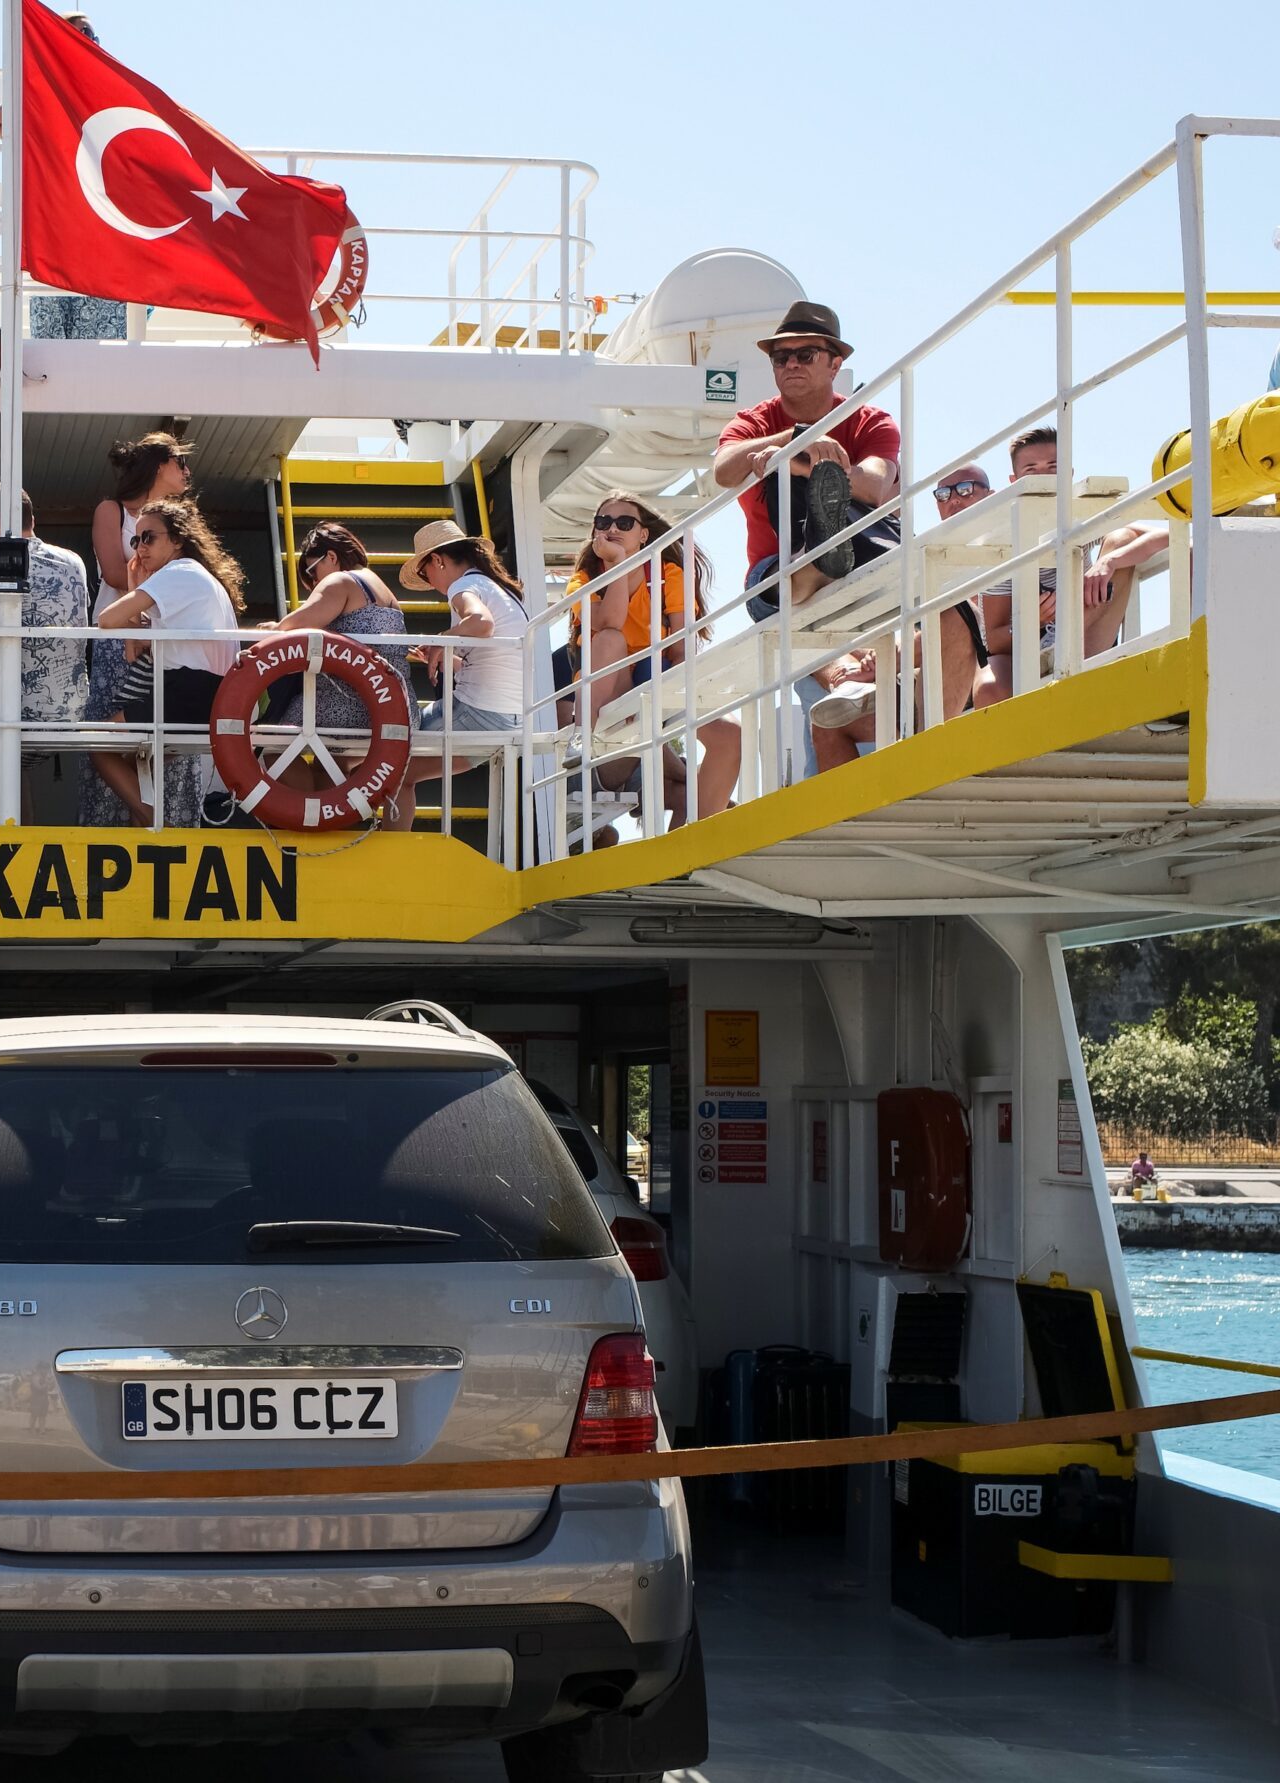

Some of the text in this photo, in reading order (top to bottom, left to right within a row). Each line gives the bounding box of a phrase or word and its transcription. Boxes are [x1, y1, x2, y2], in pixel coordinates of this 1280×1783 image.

[256, 643, 392, 704] ASIM KAPTAN
[705, 1090, 735, 1098] Security
[508, 1298, 552, 1314] CDI
[152, 1386, 386, 1432] SH06 CCZ
[127, 1421, 144, 1431] GB
[977, 1488, 1038, 1513] BILGE
